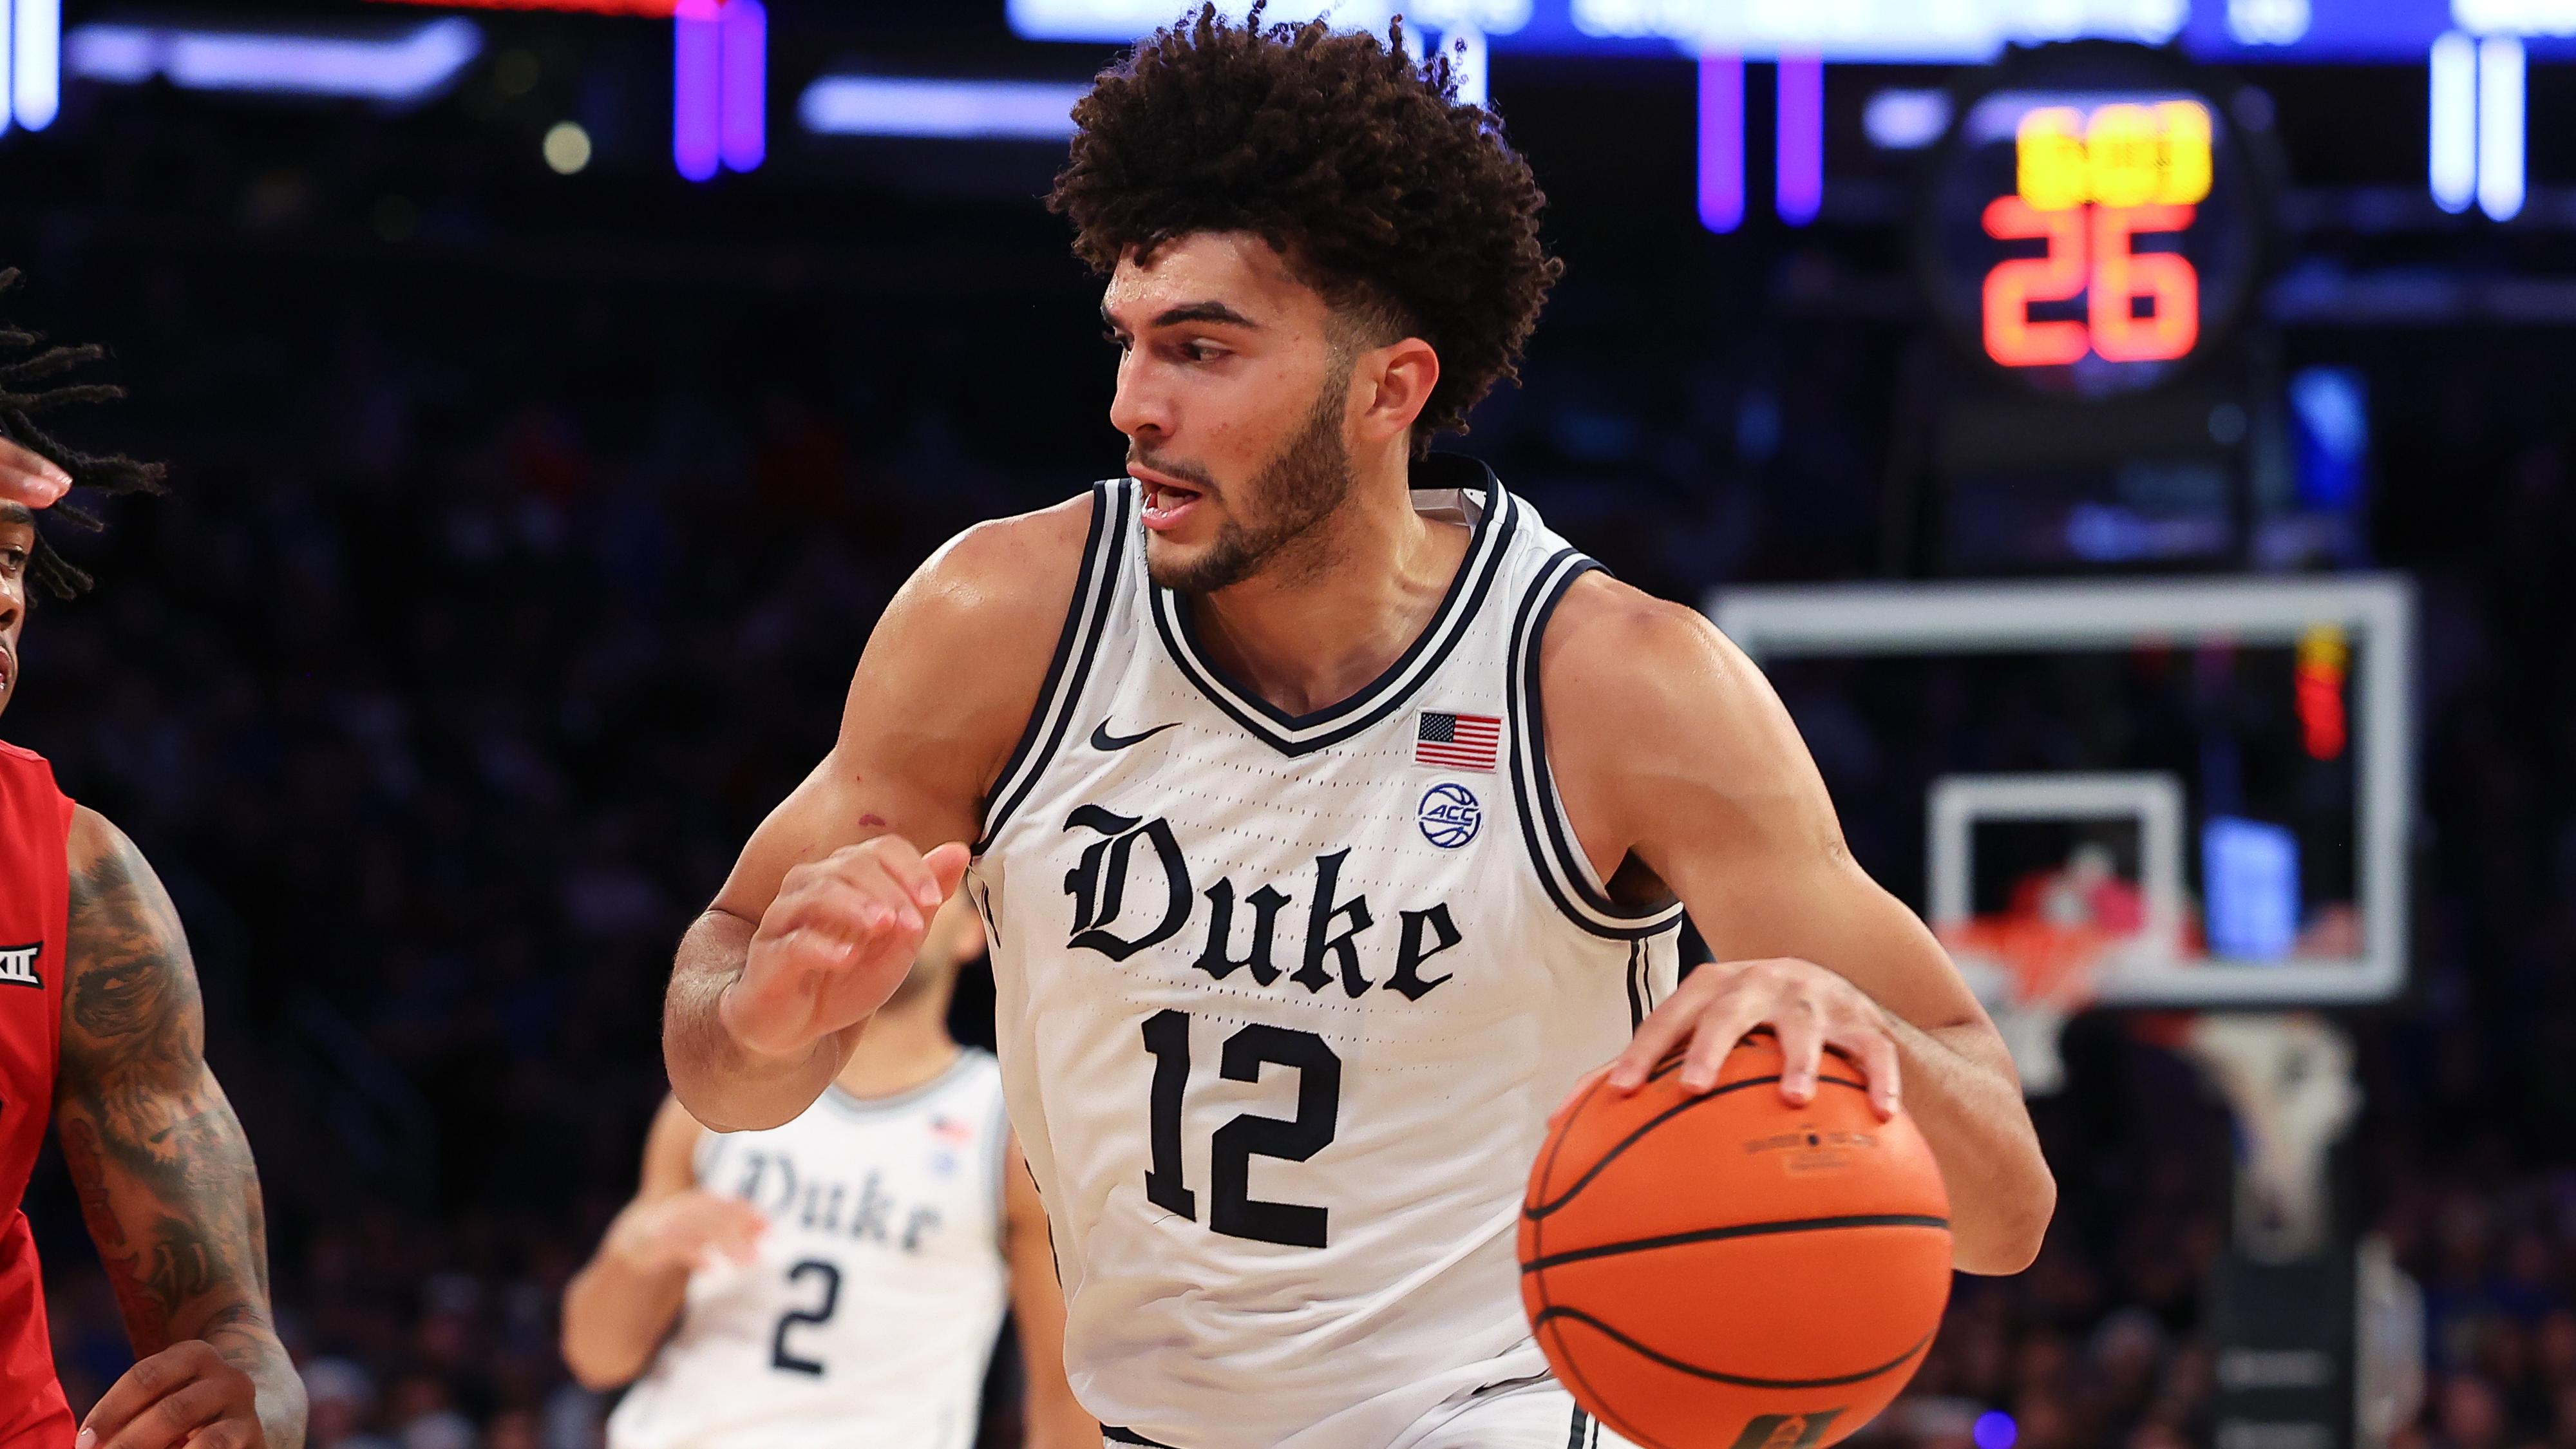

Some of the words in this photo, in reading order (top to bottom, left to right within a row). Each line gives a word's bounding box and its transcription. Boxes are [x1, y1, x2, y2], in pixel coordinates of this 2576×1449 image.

[1981, 195, 2199, 367] 26
[1426, 804, 1479, 822] ACC
[1063, 804, 1463, 1001] Duke
[1141, 1009, 1341, 1249] 12
[770, 1258, 841, 1376] 2
